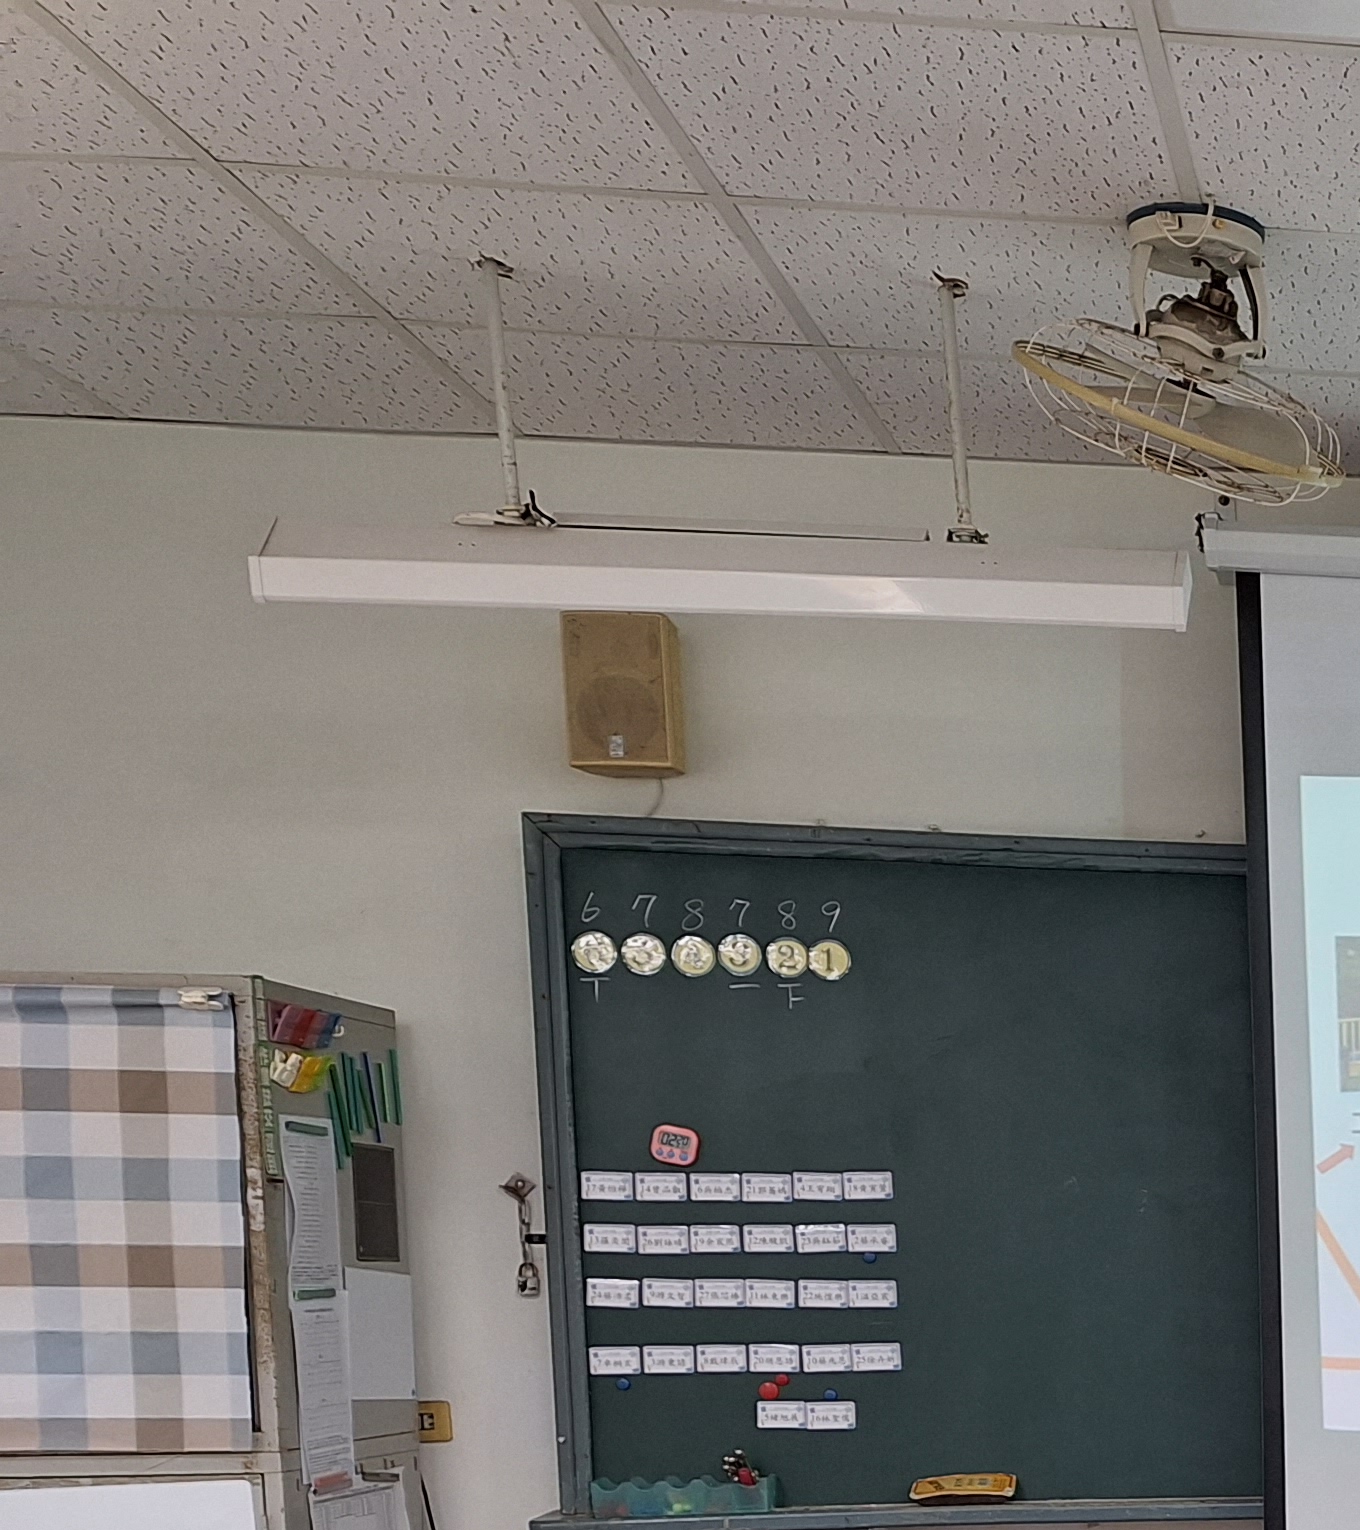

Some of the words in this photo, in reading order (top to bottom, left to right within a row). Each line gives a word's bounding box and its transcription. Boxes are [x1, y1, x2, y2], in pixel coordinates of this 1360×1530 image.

[581, 892, 600, 922] 6
[632, 894, 657, 928] 7
[682, 899, 704, 931] 8
[729, 899, 750, 927] 7
[777, 901, 796, 931] 8
[821, 901, 840, 933] 9
[778, 944, 799, 971] 2
[825, 947, 836, 973] 1
